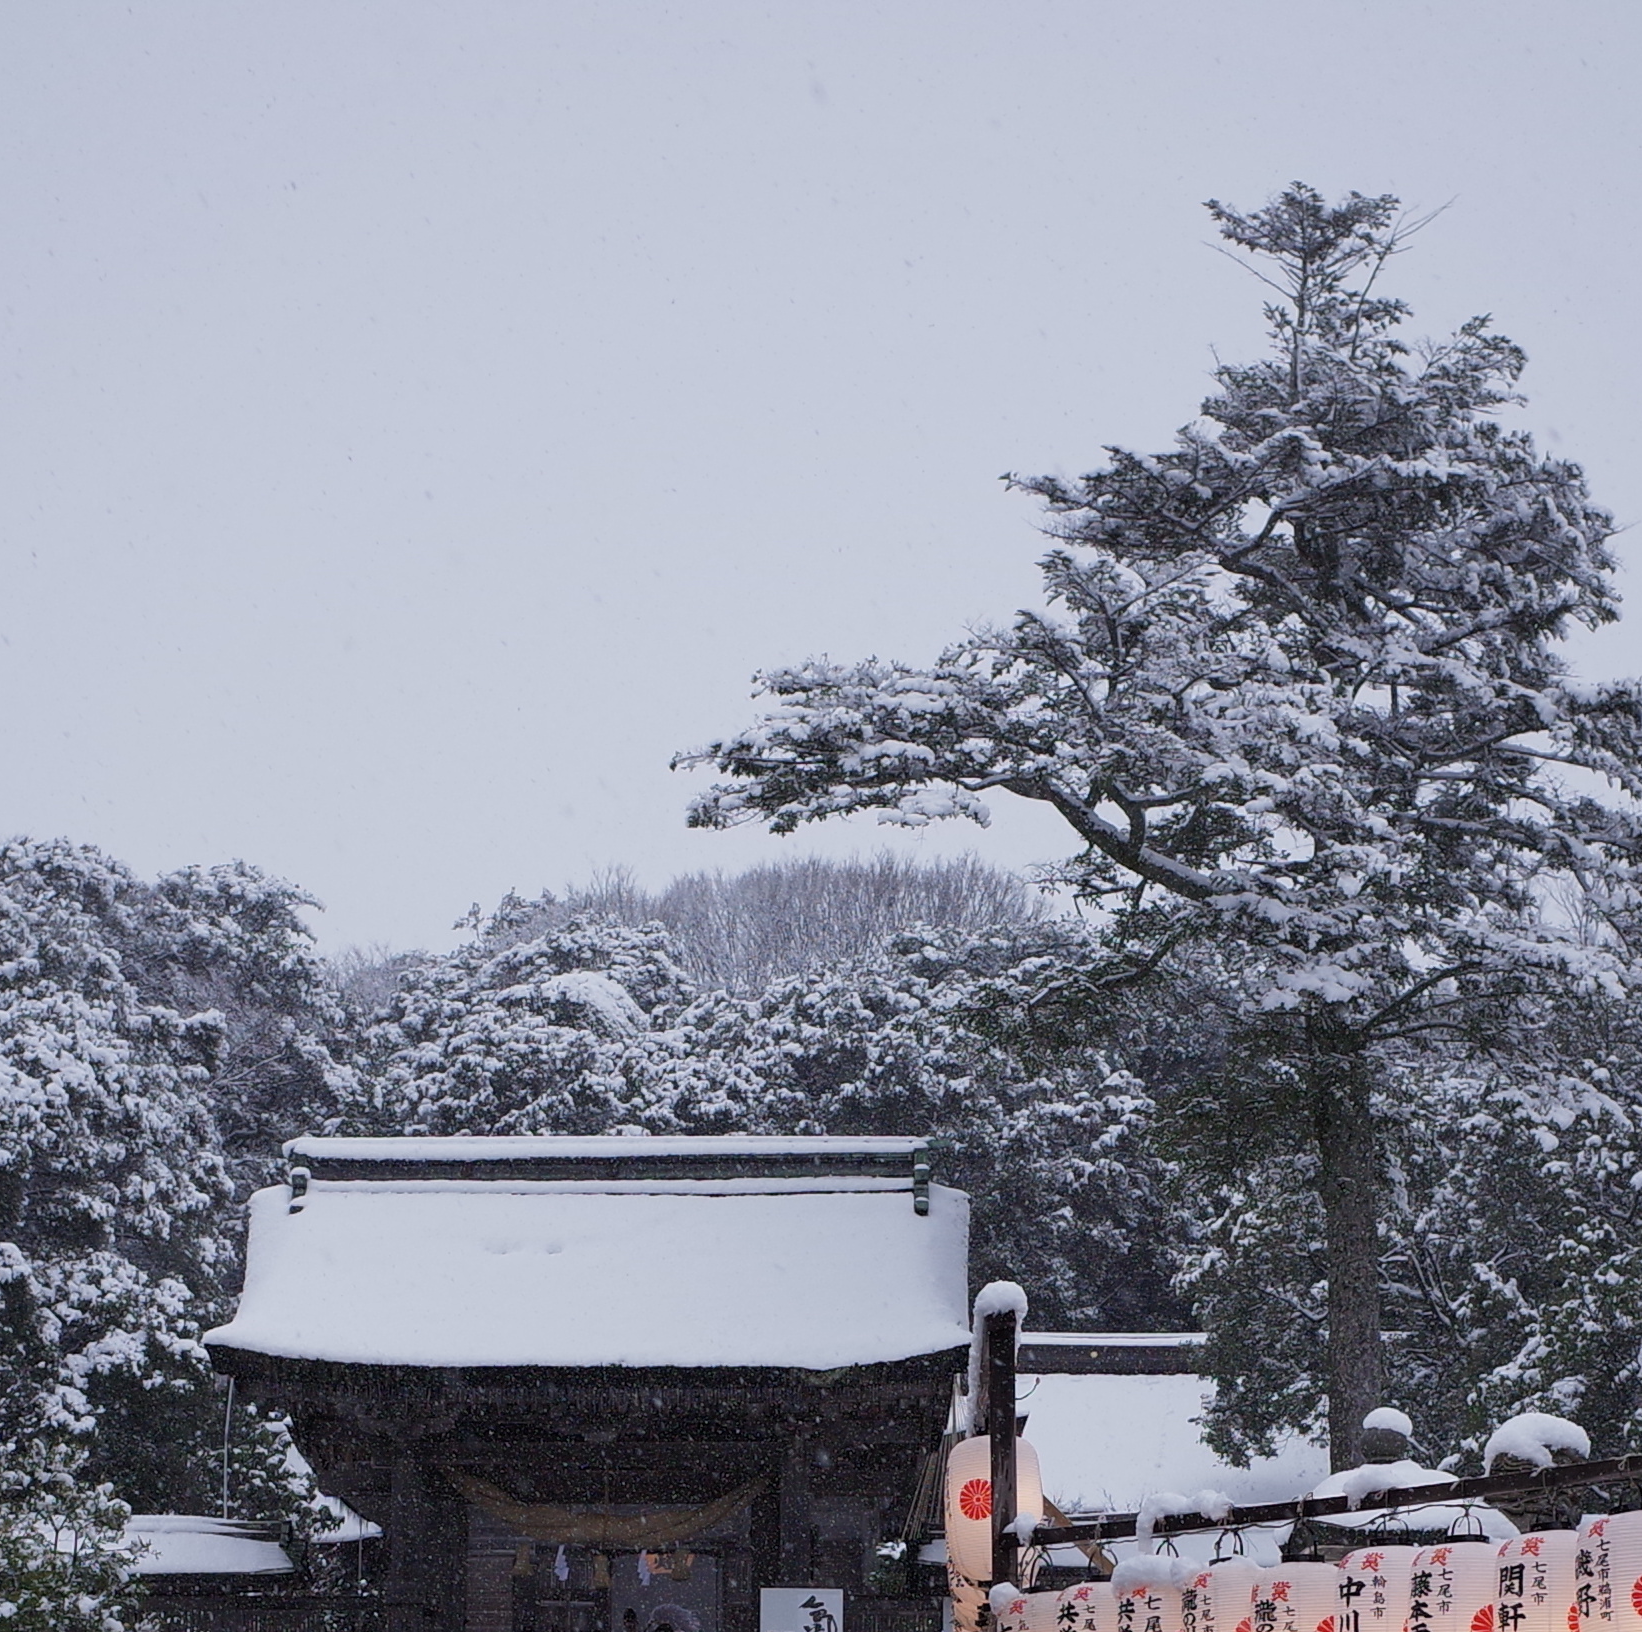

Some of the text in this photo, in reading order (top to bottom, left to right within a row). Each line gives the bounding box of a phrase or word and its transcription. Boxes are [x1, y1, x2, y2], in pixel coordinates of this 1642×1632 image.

[1370, 1574, 1388, 1621] 輪島市
[1436, 1567, 1453, 1616] 七尾市
[1530, 1560, 1549, 1607] 七尾市
